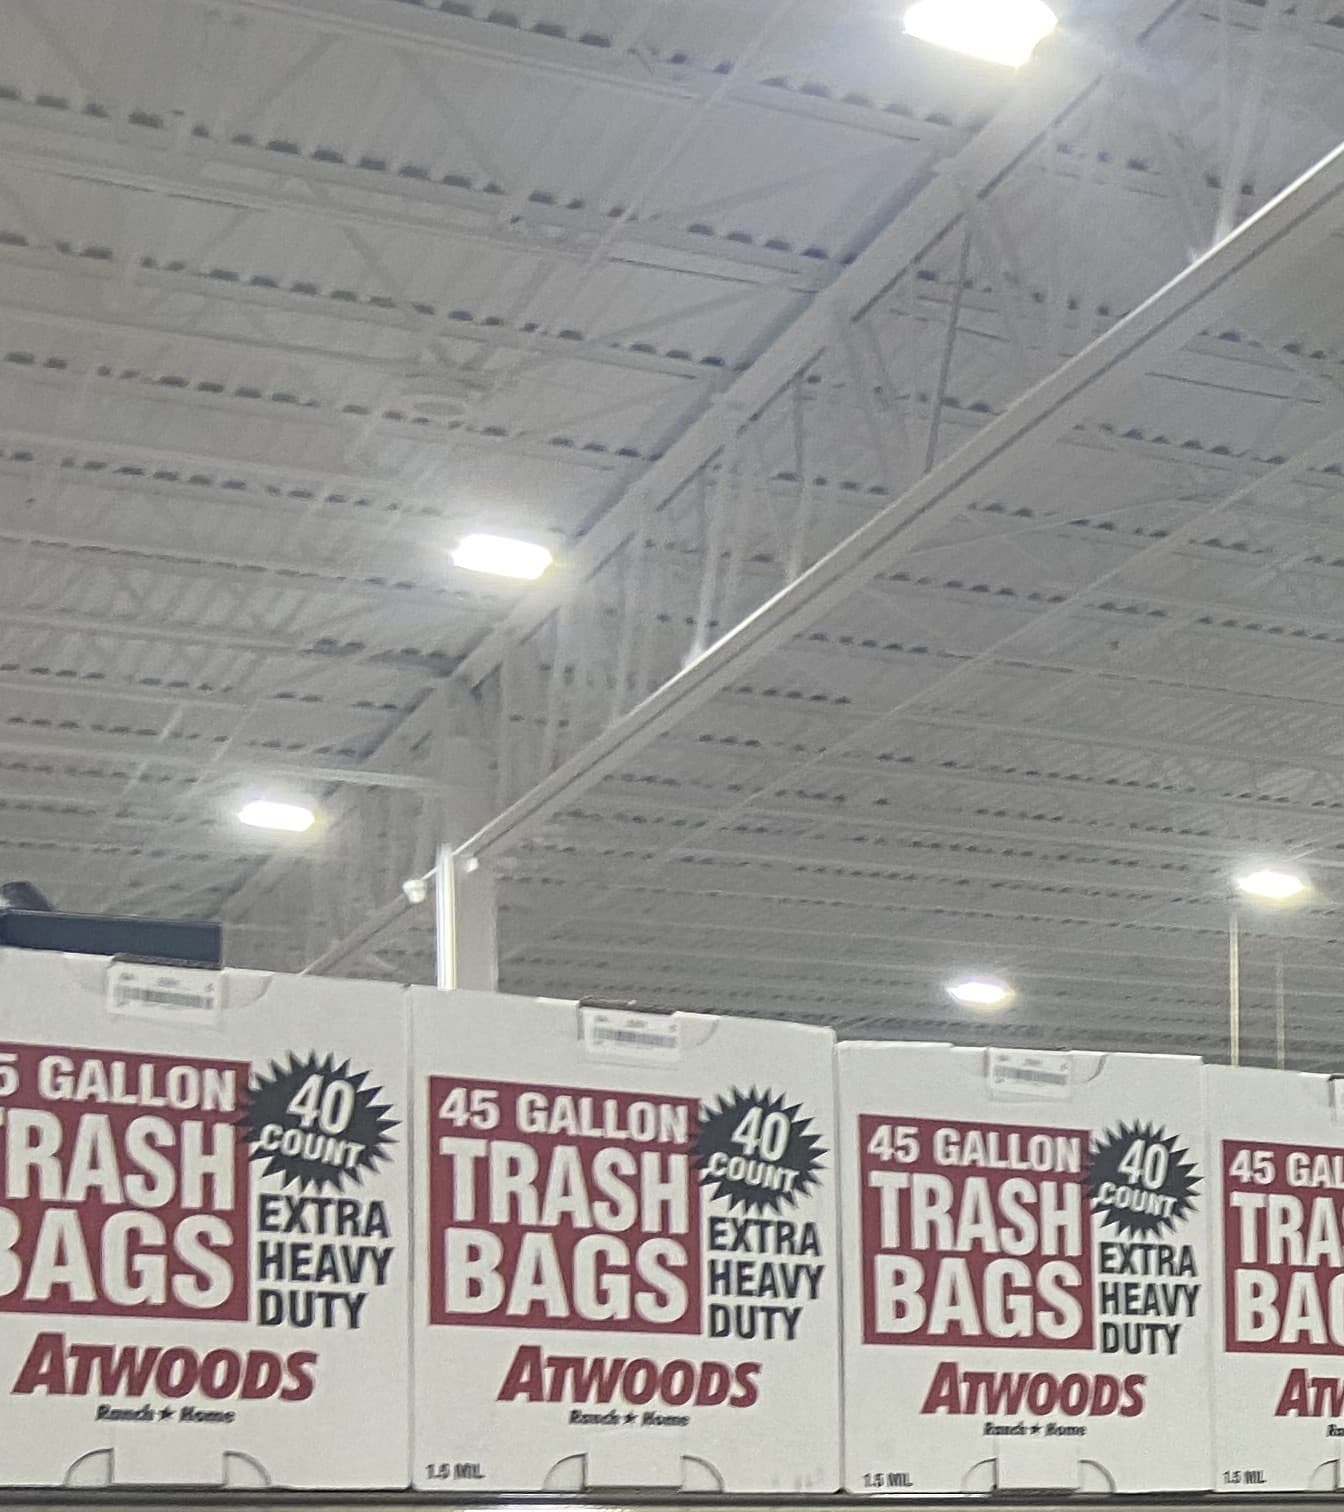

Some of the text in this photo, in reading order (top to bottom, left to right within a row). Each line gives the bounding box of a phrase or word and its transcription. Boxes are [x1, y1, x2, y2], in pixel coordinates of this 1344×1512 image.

[438, 1088, 688, 1144] 45 GALLON
[732, 1107, 790, 1161] 40
[439, 1136, 688, 1236] TRASH
[707, 1152, 800, 1193] COUNT
[1229, 1149, 1274, 1185] 45
[709, 1217, 821, 1256] EXTRA
[444, 1227, 689, 1326] BAGS
[708, 1259, 826, 1300] HEAVY
[709, 1304, 802, 1340] DUTY
[495, 1345, 761, 1410] ATWOODS
